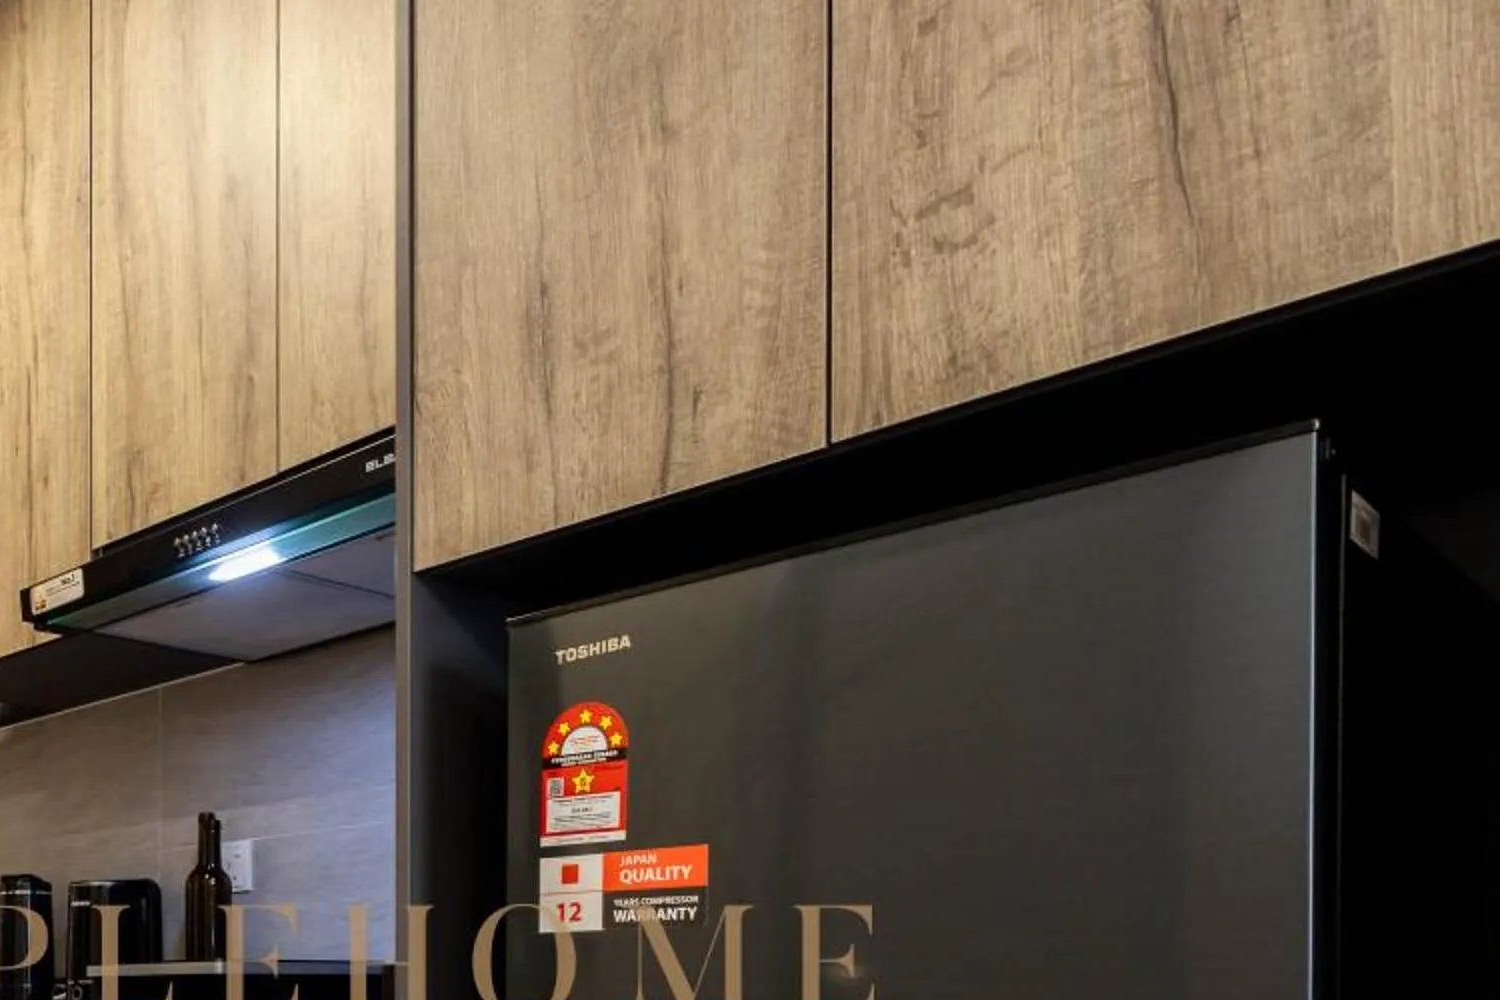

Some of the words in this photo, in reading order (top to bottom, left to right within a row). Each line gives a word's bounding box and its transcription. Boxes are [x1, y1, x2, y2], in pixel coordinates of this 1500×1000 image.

[556, 634, 631, 665] TOSHIBA
[620, 853, 657, 867] JAPAN
[620, 865, 692, 884] QUALITY
[556, 902, 582, 922] 12
